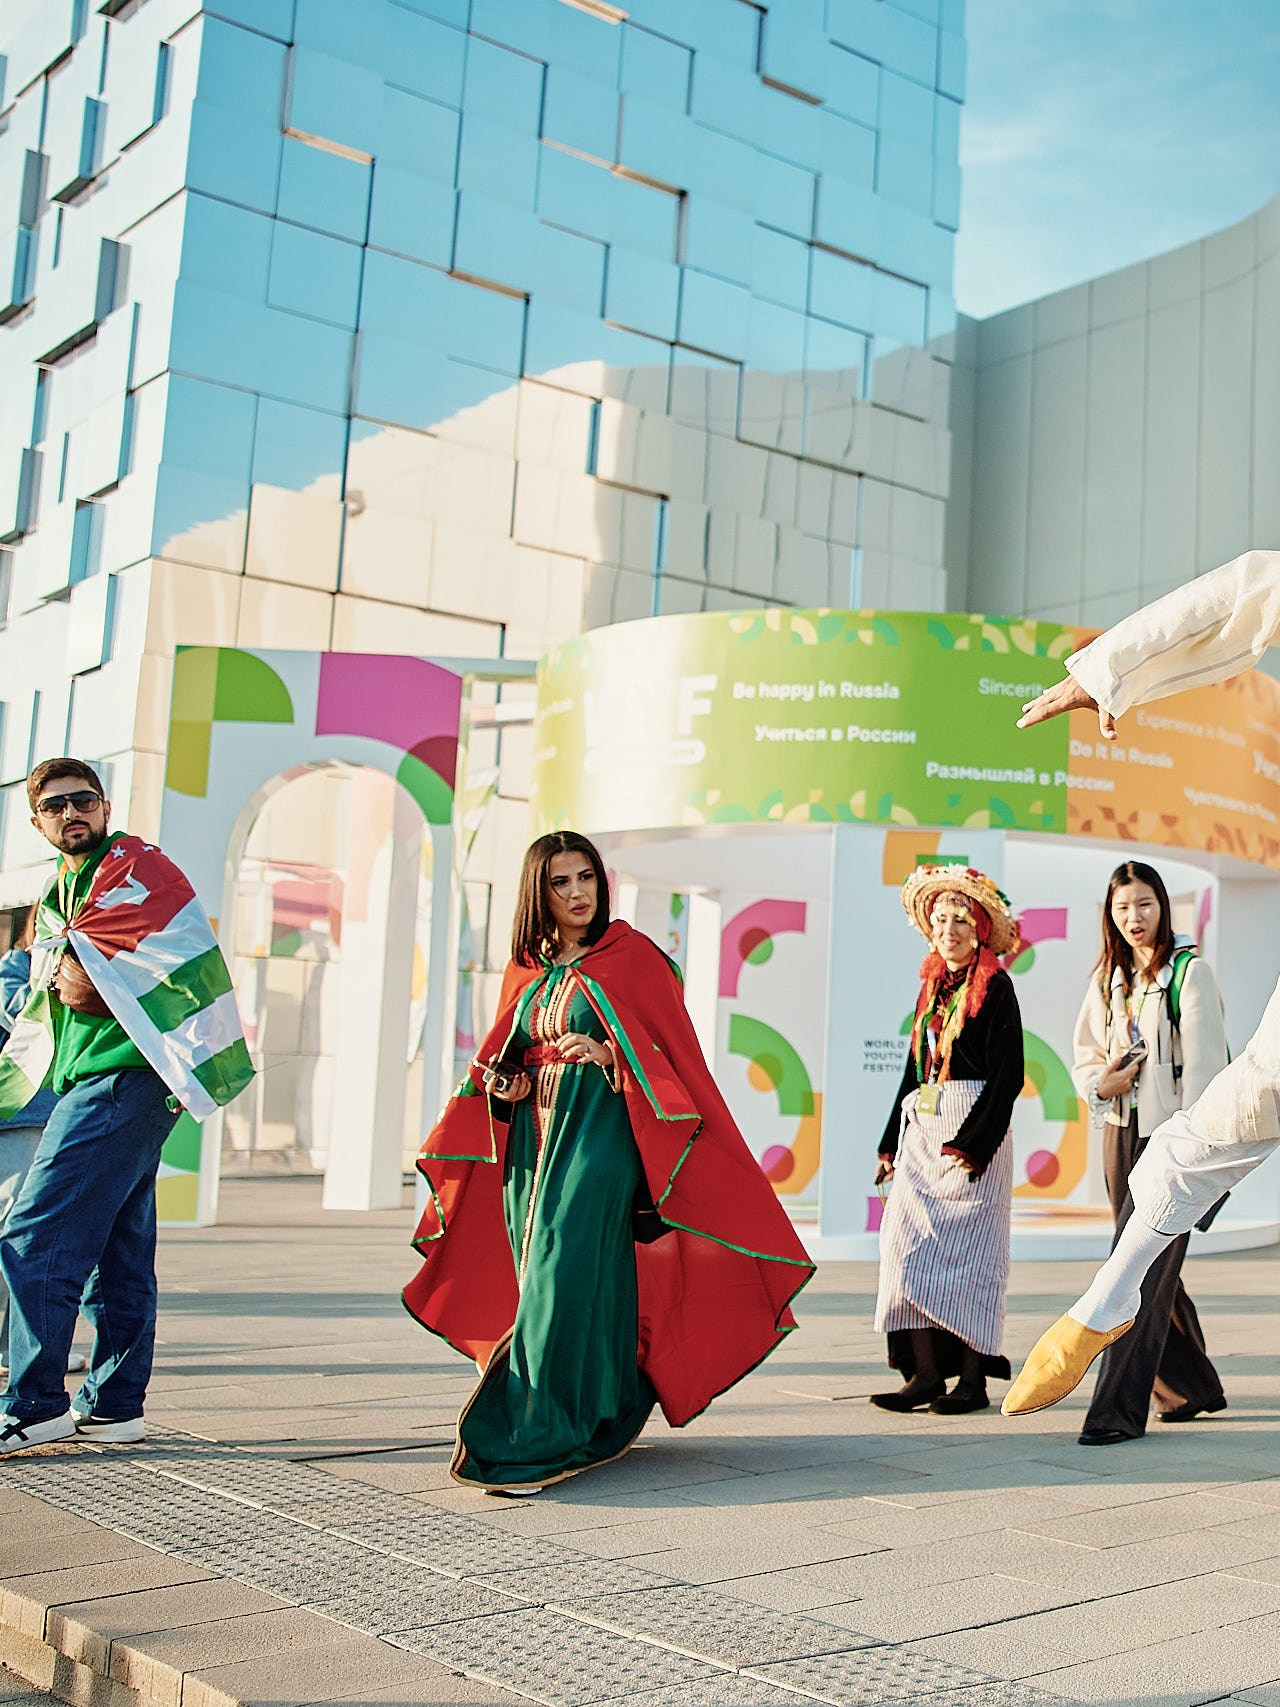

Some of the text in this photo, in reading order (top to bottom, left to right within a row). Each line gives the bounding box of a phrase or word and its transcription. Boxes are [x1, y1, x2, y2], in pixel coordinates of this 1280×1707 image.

[733, 680, 899, 701] Be happy in Russia
[979, 677, 1044, 698] Sincerit
[755, 725, 916, 743] Учиться в России
[1069, 739, 1174, 769] Do it in Russia
[926, 761, 1115, 792] Размышляй в России
[863, 1039, 905, 1049] WORLD
[863, 1051, 903, 1061] YOUTH
[863, 1063, 904, 1073] FESTIV
